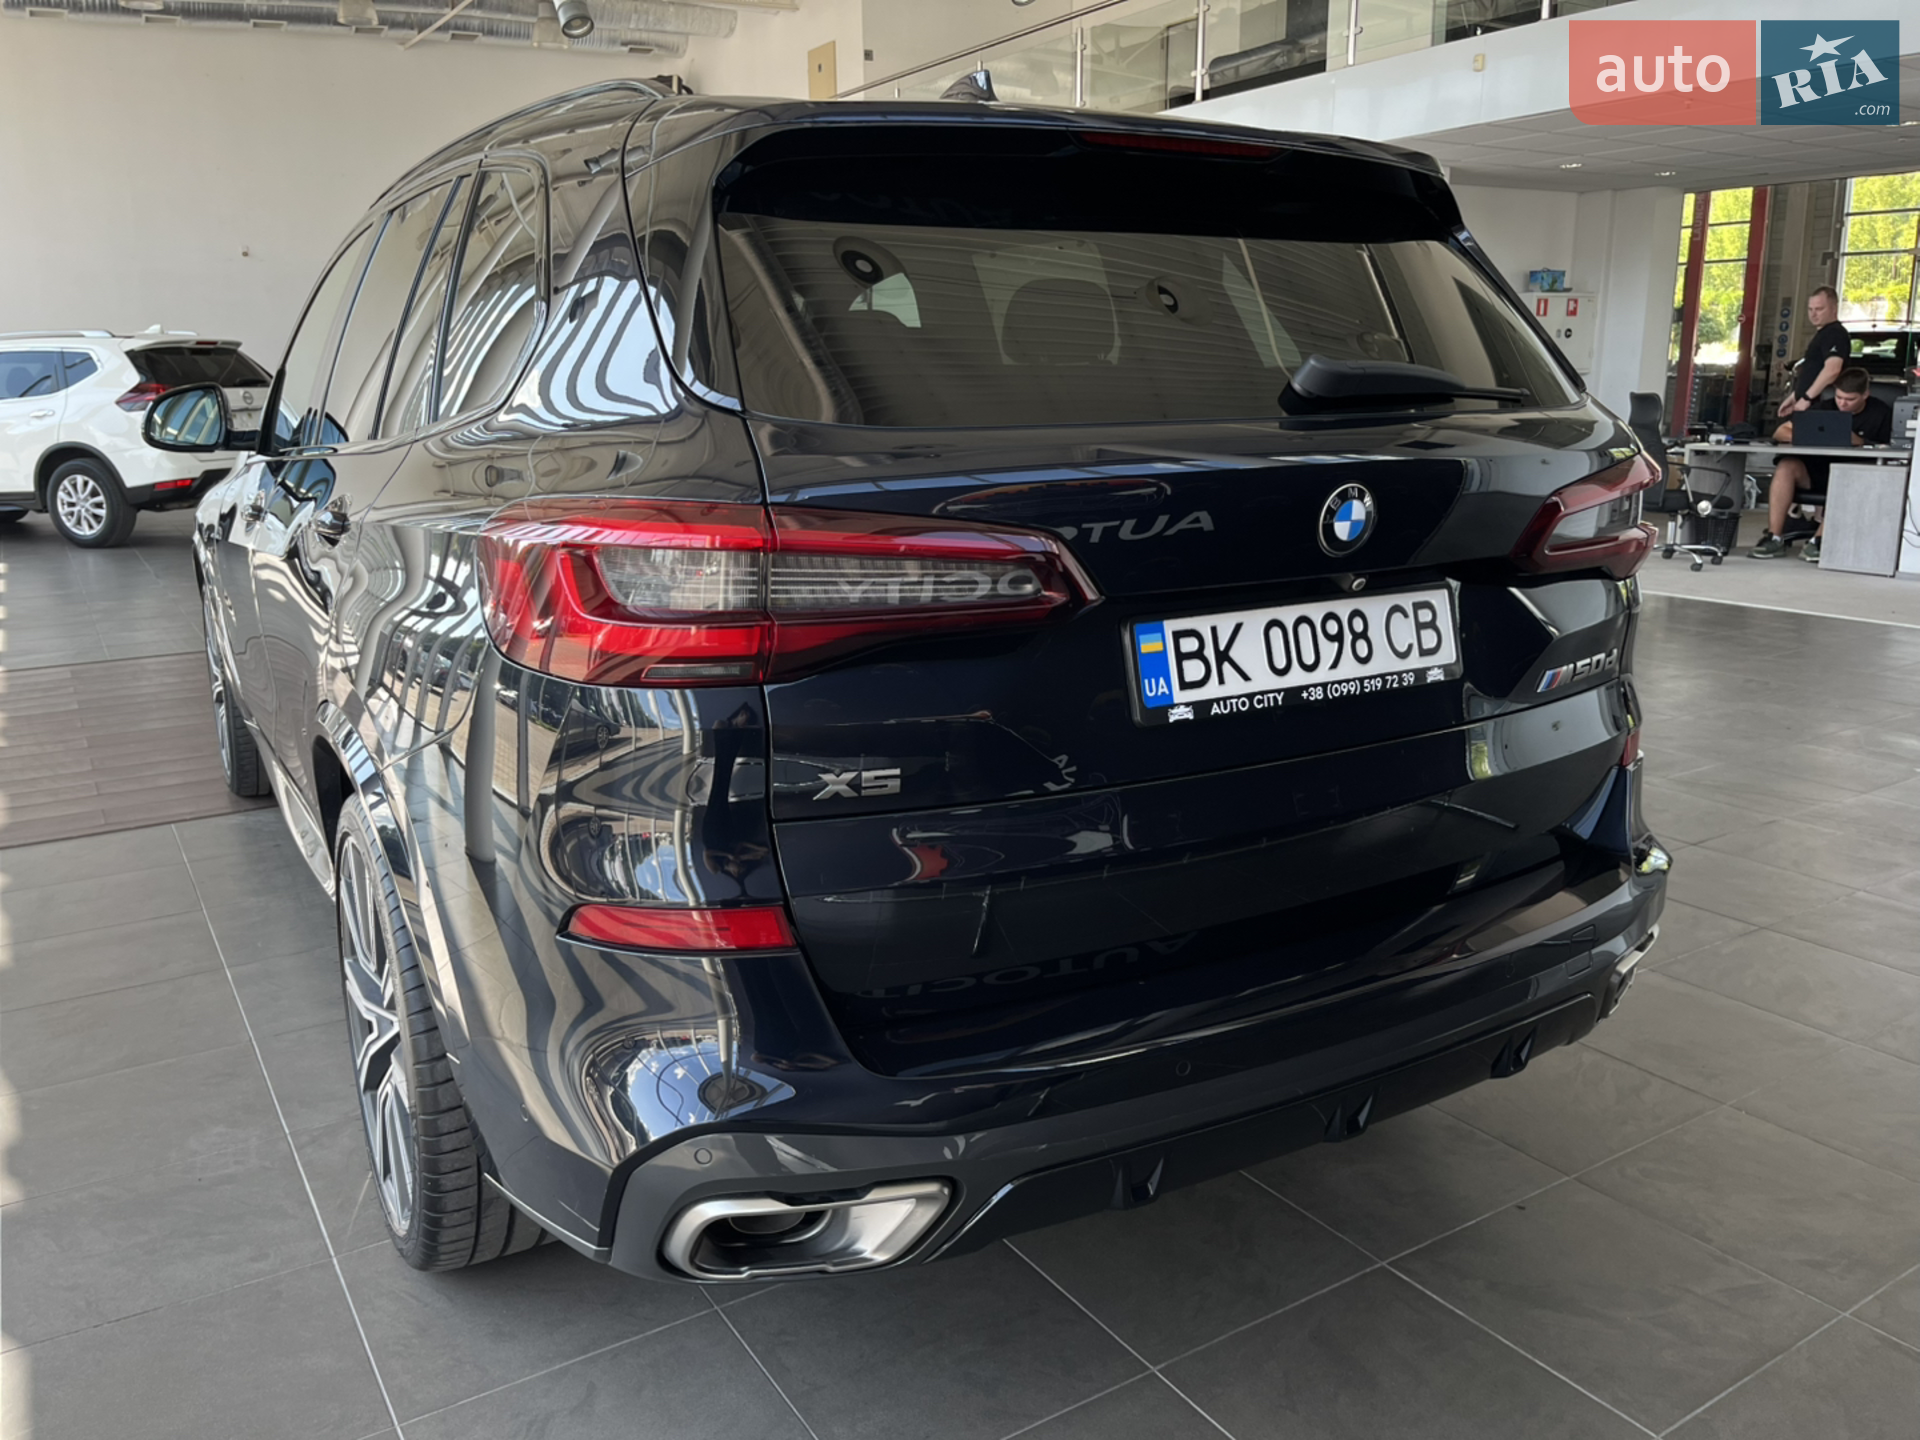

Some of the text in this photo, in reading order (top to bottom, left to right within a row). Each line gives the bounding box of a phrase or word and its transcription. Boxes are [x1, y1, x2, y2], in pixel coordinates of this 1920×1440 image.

[1329, 487, 1373, 511] BMW
[1171, 600, 1443, 692] BK 0098 CB
[1144, 677, 1169, 698] UA
[1301, 672, 1415, 701] +38 (099) 519 72 39
[1210, 691, 1285, 716] AUTO CITY
[813, 768, 901, 800] X5
